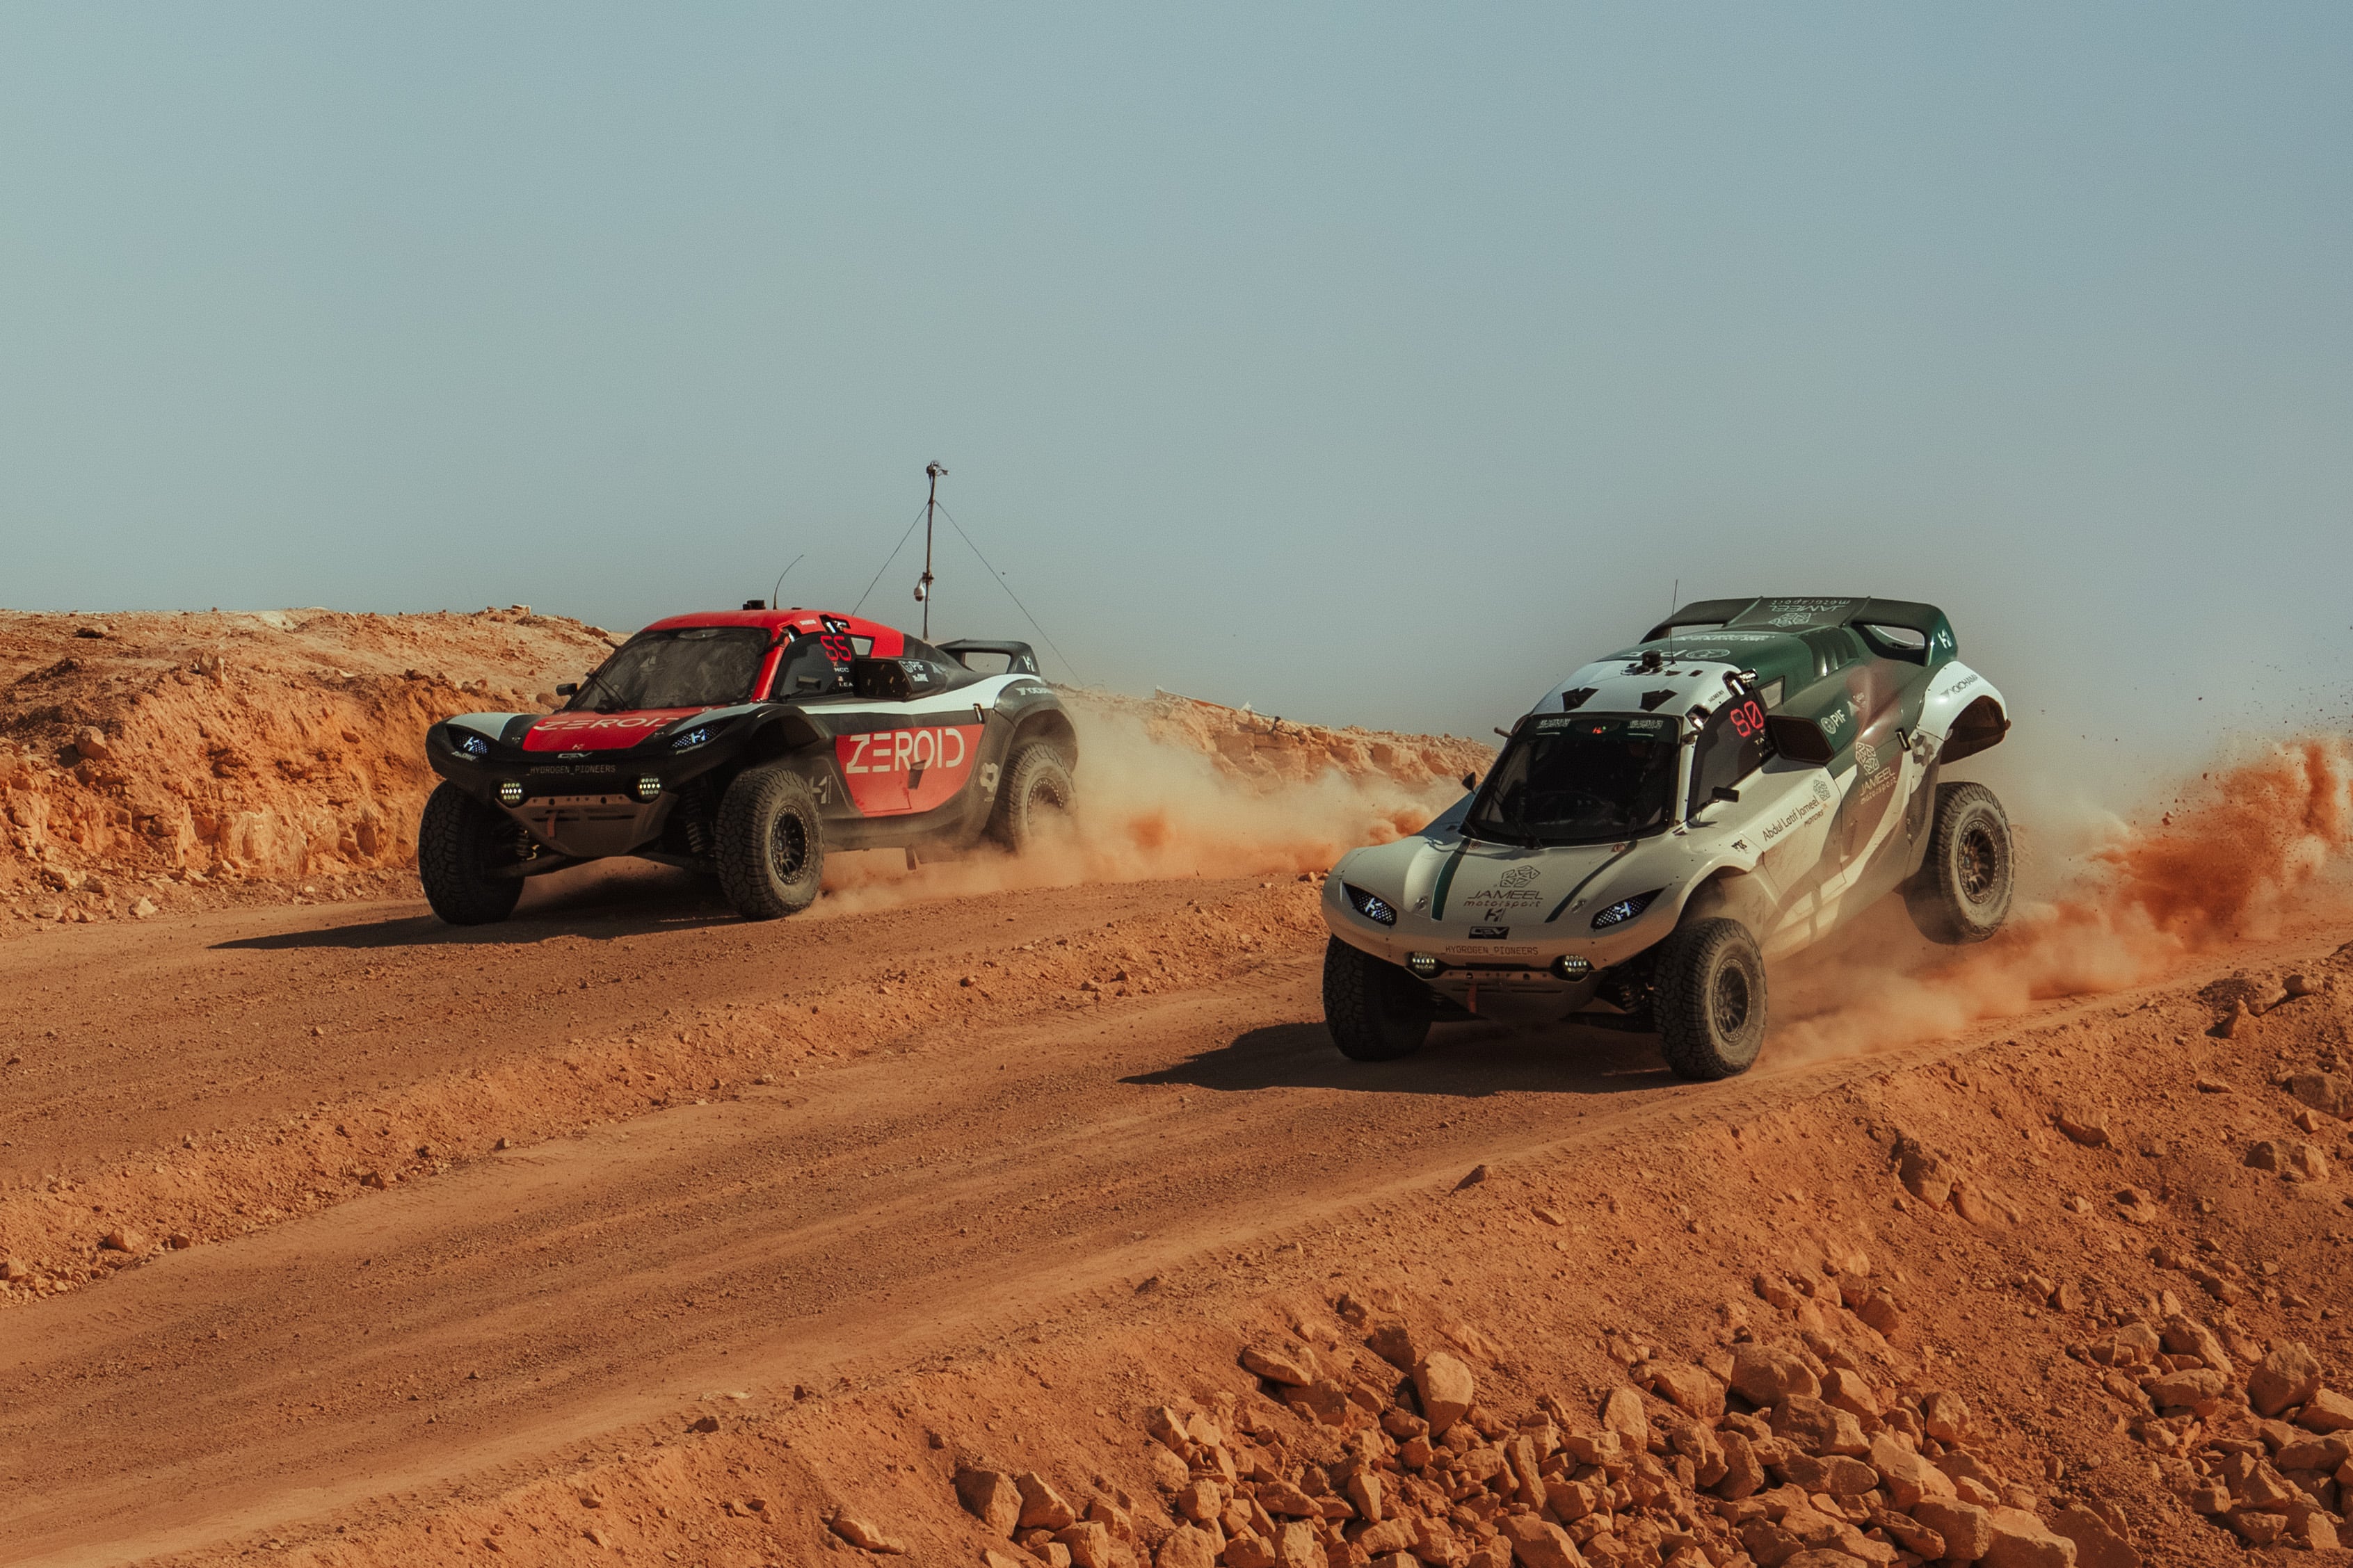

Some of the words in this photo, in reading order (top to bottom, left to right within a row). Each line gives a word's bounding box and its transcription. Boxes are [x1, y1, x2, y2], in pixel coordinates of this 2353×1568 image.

[1730, 700, 1765, 737] 80
[1829, 709, 1847, 727] PIF
[846, 727, 965, 774] ZEROID
[1859, 766, 1896, 796] JAMEEL
[1861, 776, 1897, 805] motorsport
[1762, 818, 1784, 841] Abdul
[1463, 900, 1541, 909] motorsport
[1467, 890, 1543, 900] JAMEEL
